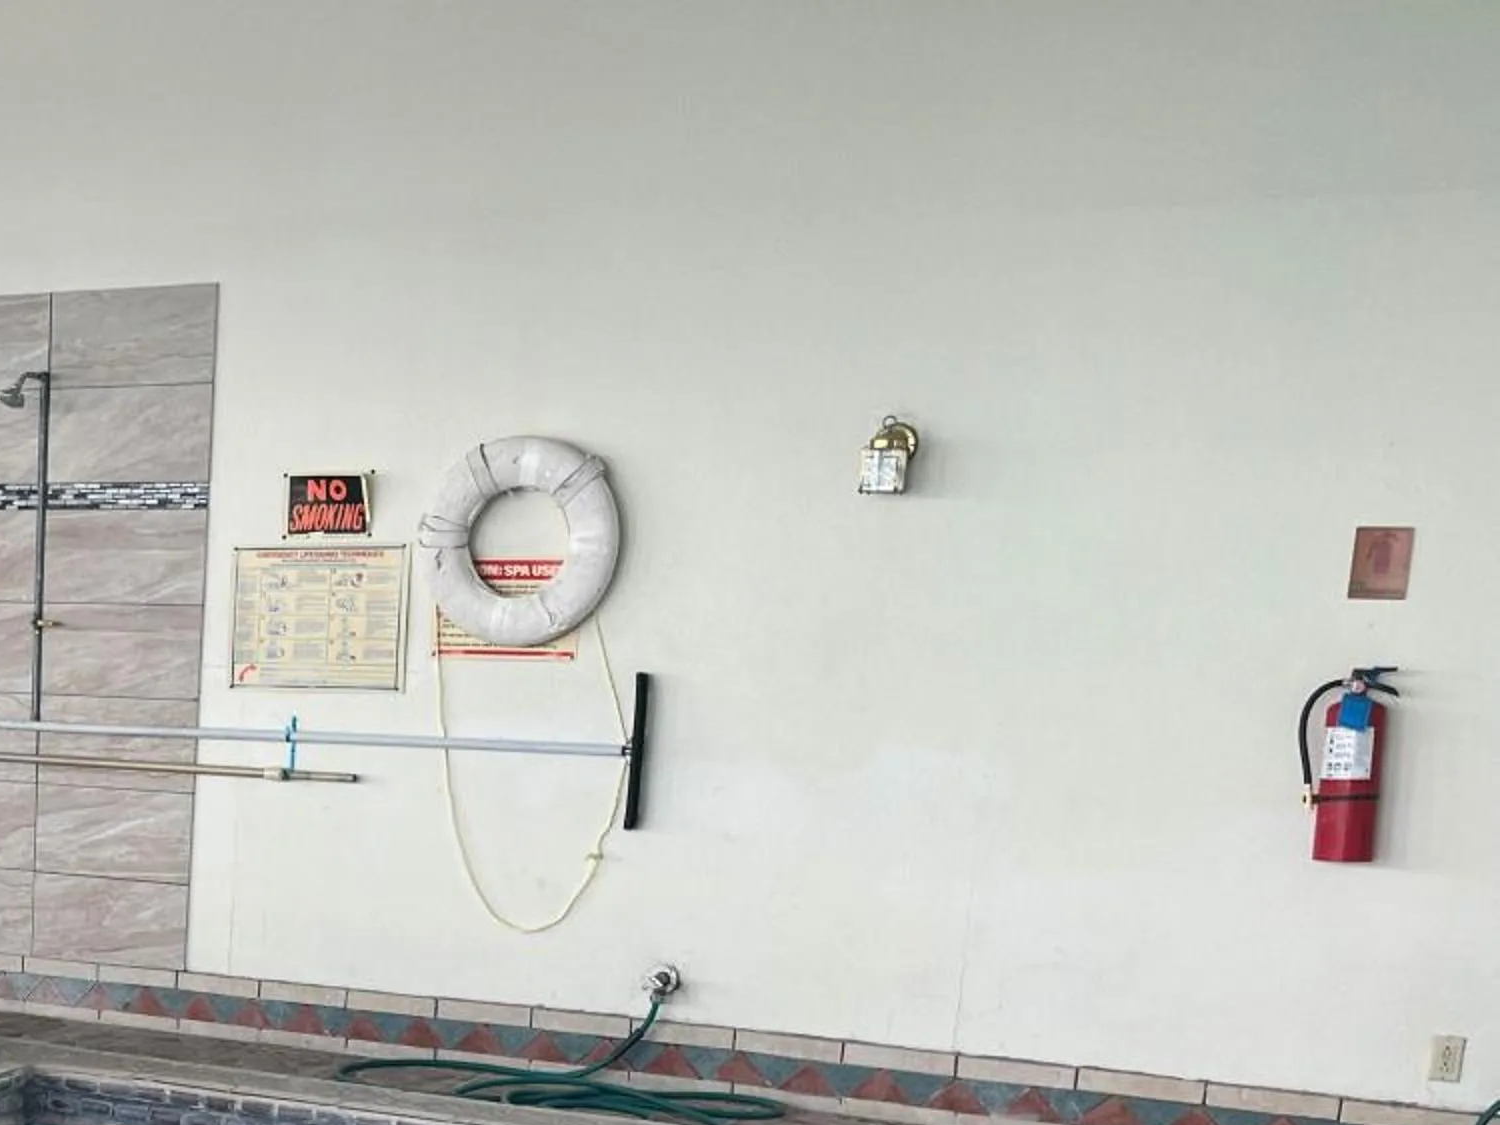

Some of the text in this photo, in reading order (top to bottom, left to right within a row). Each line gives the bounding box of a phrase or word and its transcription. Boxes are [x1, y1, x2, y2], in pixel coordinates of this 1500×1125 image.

[307, 479, 347, 502] NO
[289, 503, 365, 531] SMOKING
[504, 564, 530, 577] SPA
